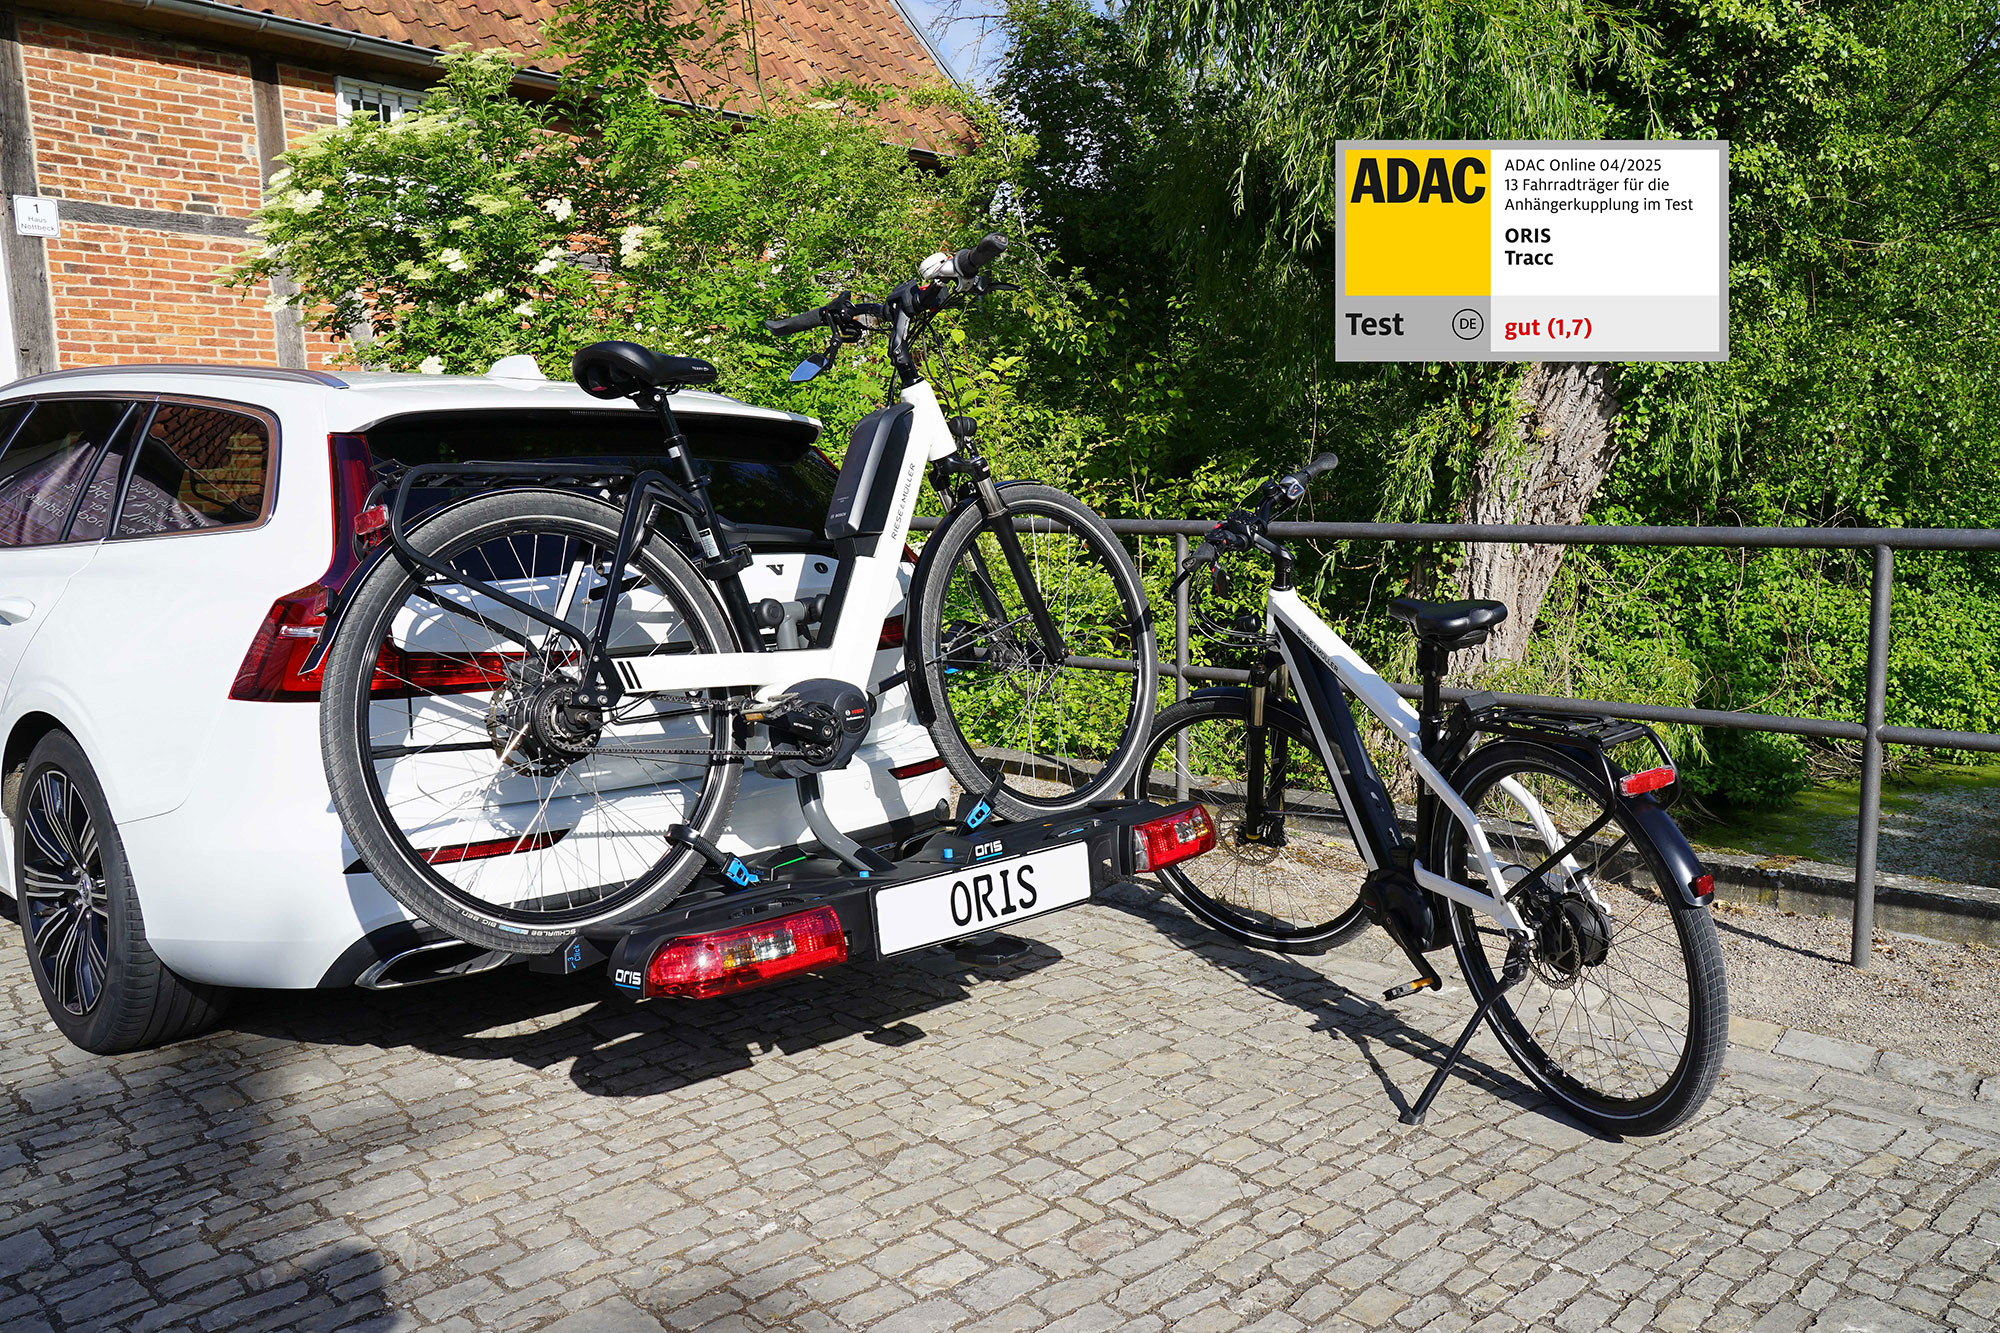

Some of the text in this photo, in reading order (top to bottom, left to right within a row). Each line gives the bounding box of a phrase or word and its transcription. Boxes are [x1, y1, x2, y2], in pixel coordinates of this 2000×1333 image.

[33, 203, 39, 214] 1
[28, 216, 47, 224] Haus
[21, 223, 56, 232] Nottbeck
[950, 864, 1037, 927] ORIS
[480, 918, 498, 929] BIG
[530, 928, 577, 937] SCHWALBE
